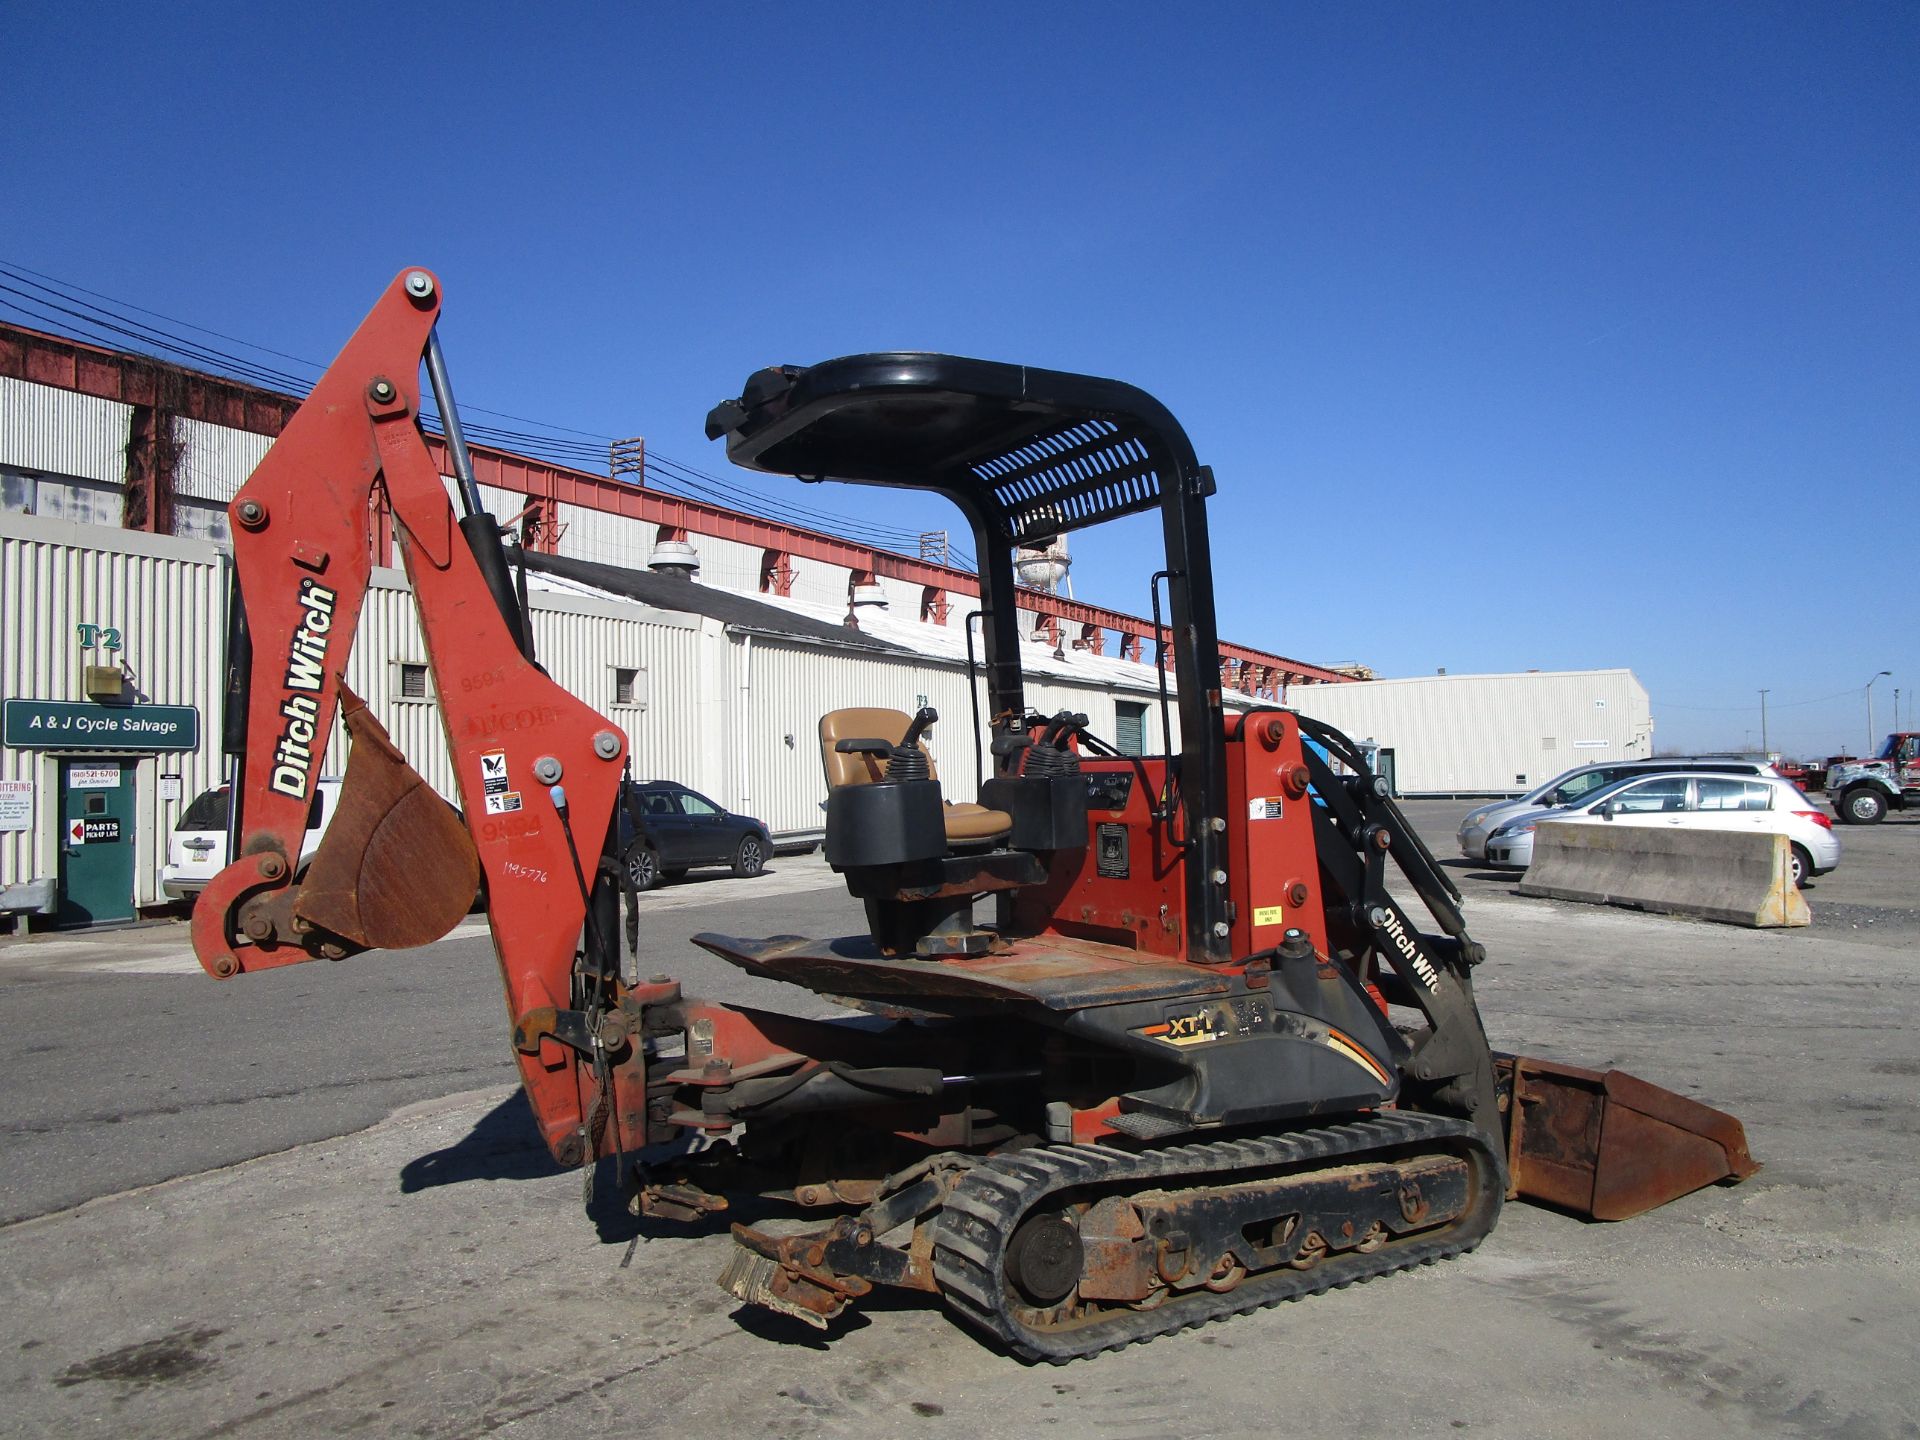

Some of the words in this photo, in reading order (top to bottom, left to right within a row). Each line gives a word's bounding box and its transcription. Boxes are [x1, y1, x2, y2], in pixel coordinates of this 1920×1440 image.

[288, 587, 334, 690] Witch
[29, 715, 42, 728] A
[46, 716, 57, 729] &
[62, 716, 71, 729] J
[76, 717, 118, 733] Cycle
[123, 718, 178, 735] Salvage
[273, 697, 317, 799] Ditch
[0, 782, 32, 792] ITERING
[86, 823, 118, 831] PARTS
[1383, 907, 1416, 960] Ditch
